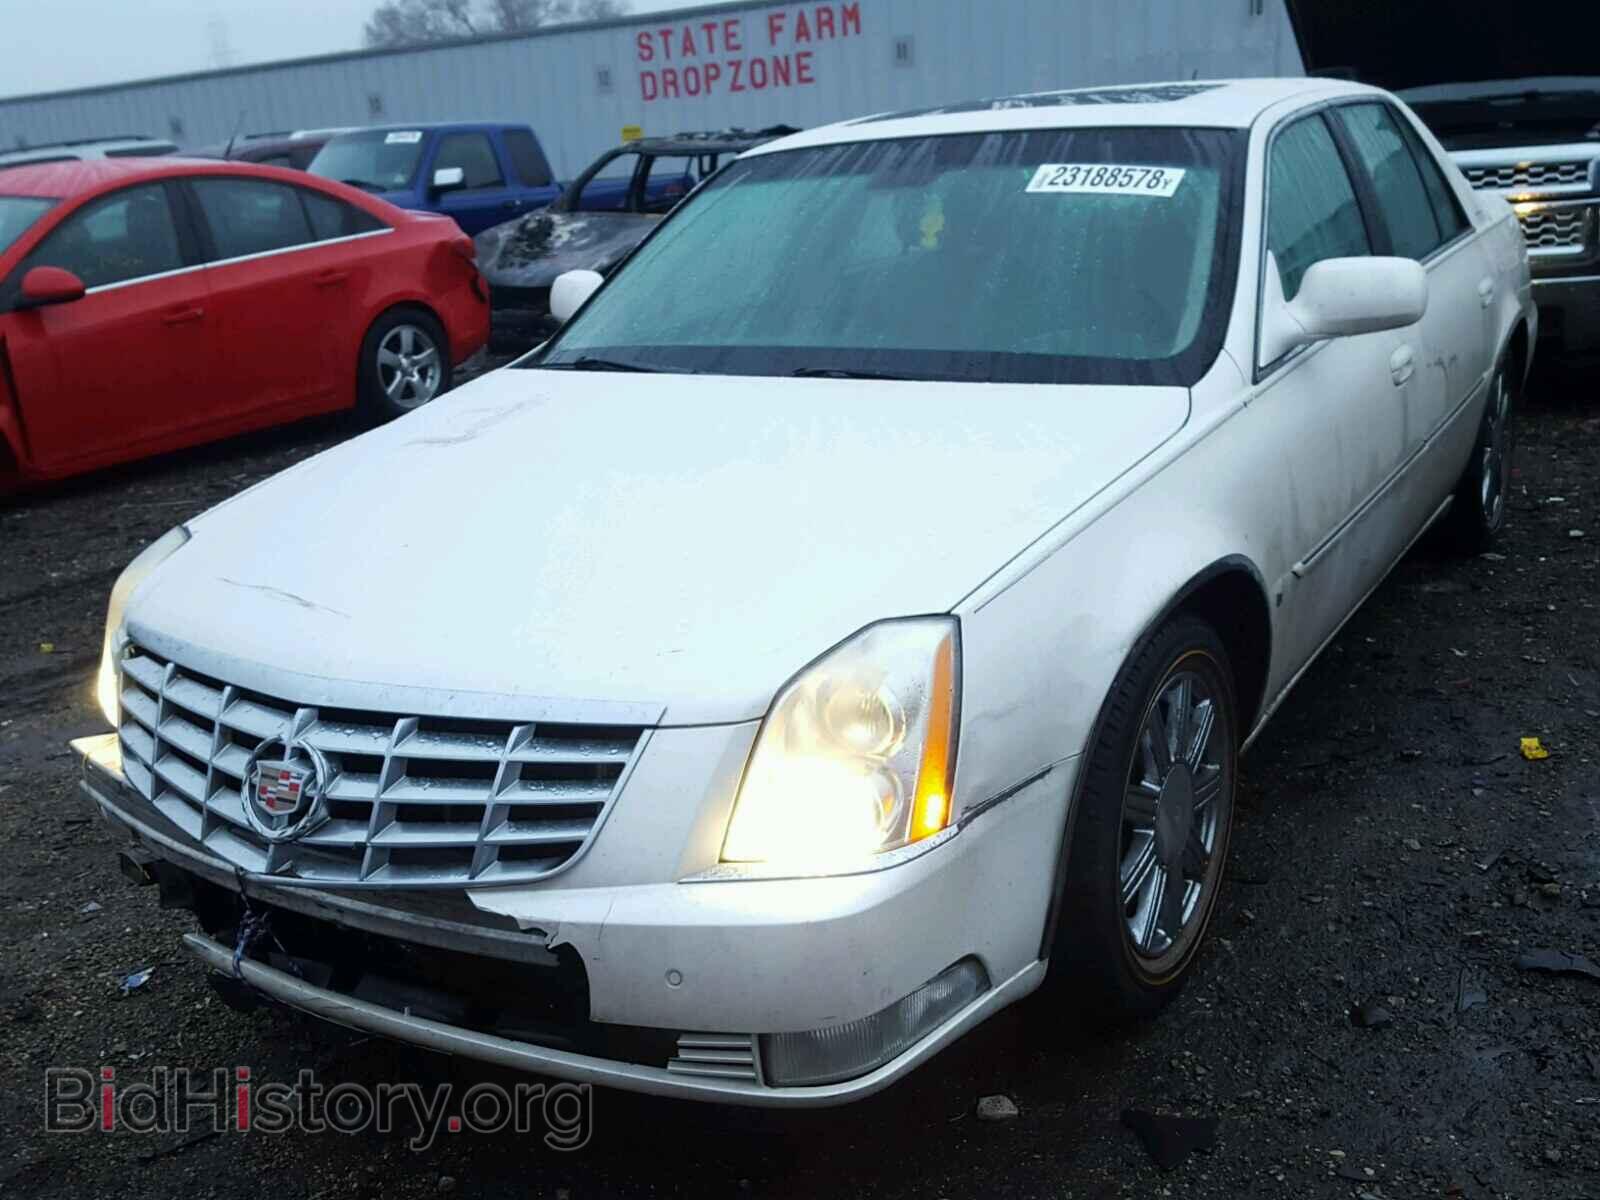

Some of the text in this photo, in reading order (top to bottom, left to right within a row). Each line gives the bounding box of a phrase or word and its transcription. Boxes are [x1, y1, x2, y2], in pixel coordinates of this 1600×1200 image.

[637, 3, 862, 61] STATE FARM
[640, 52, 815, 101] DROPZONE
